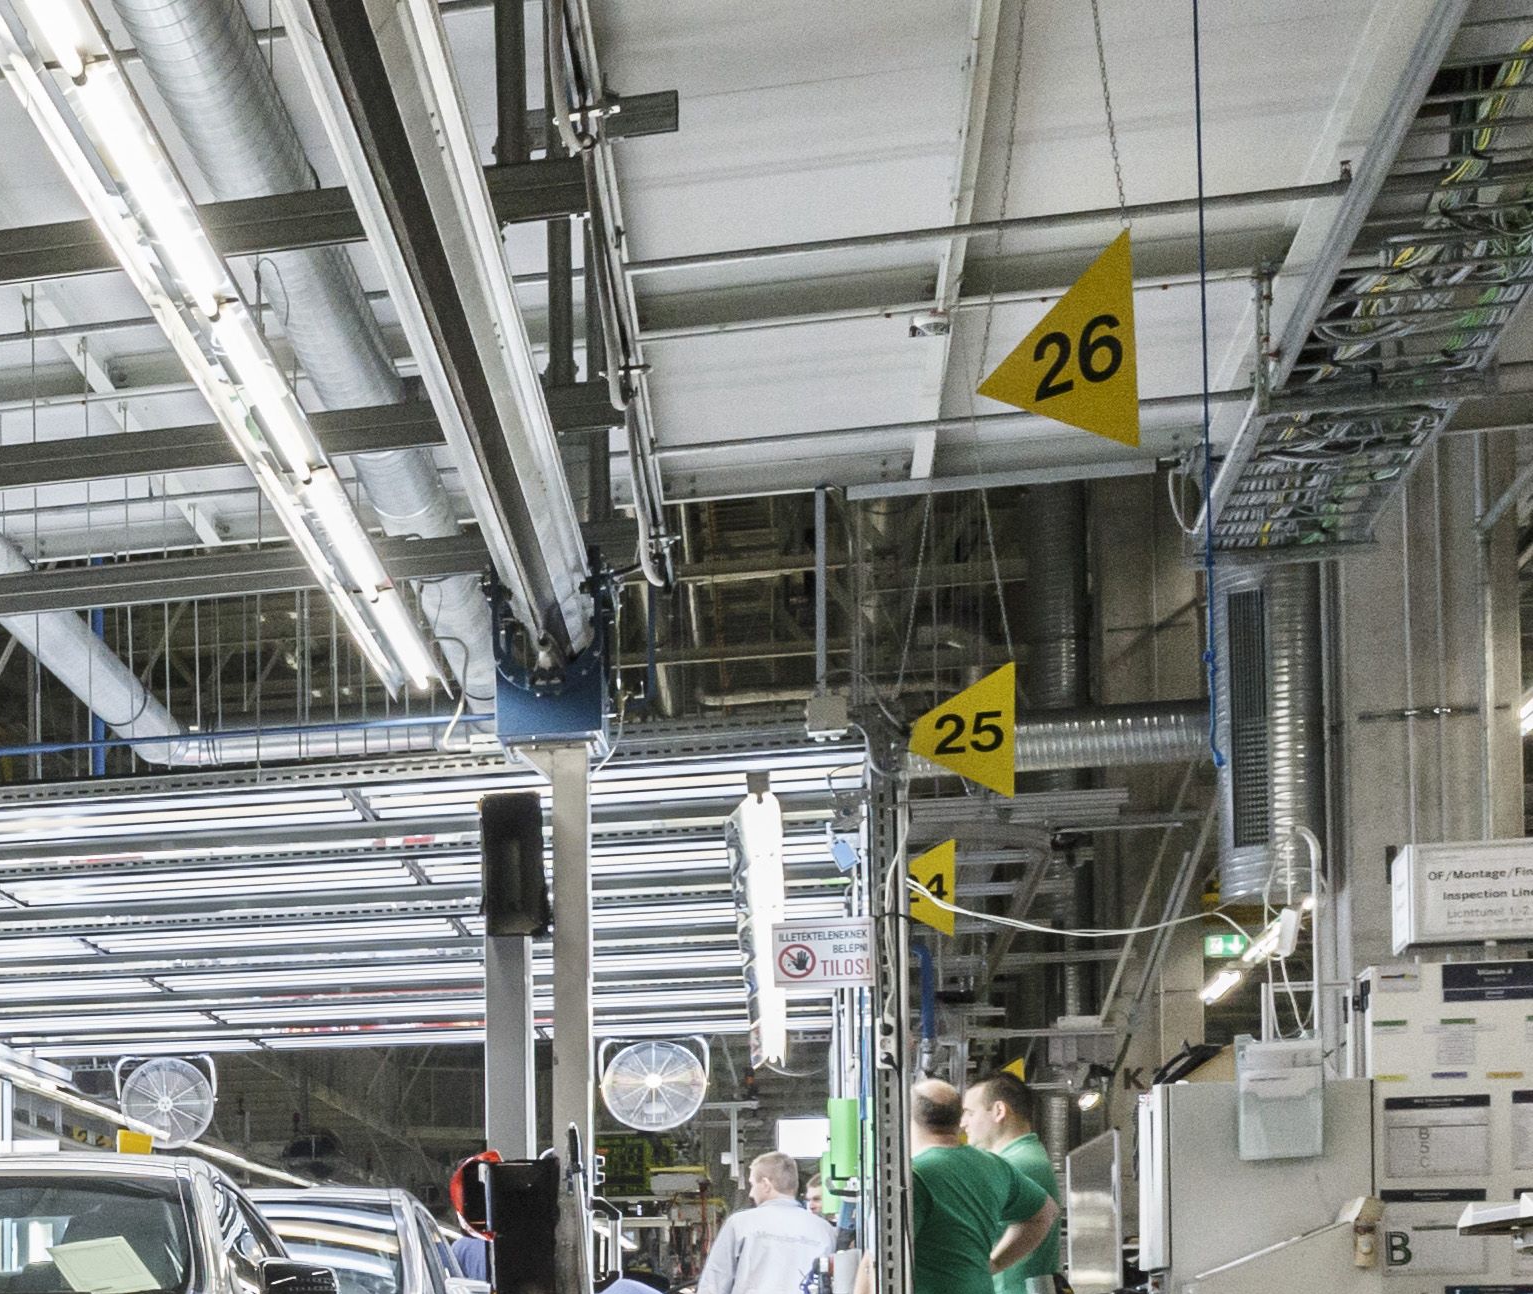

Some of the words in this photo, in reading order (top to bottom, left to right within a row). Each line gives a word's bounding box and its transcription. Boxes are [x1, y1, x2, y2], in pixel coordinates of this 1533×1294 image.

[1033, 314, 1124, 403] 26
[934, 711, 1004, 755] 25
[1443, 890, 1507, 902] Inspection
[820, 957, 871, 977] TILOS!
[1385, 1231, 1413, 1267] B
